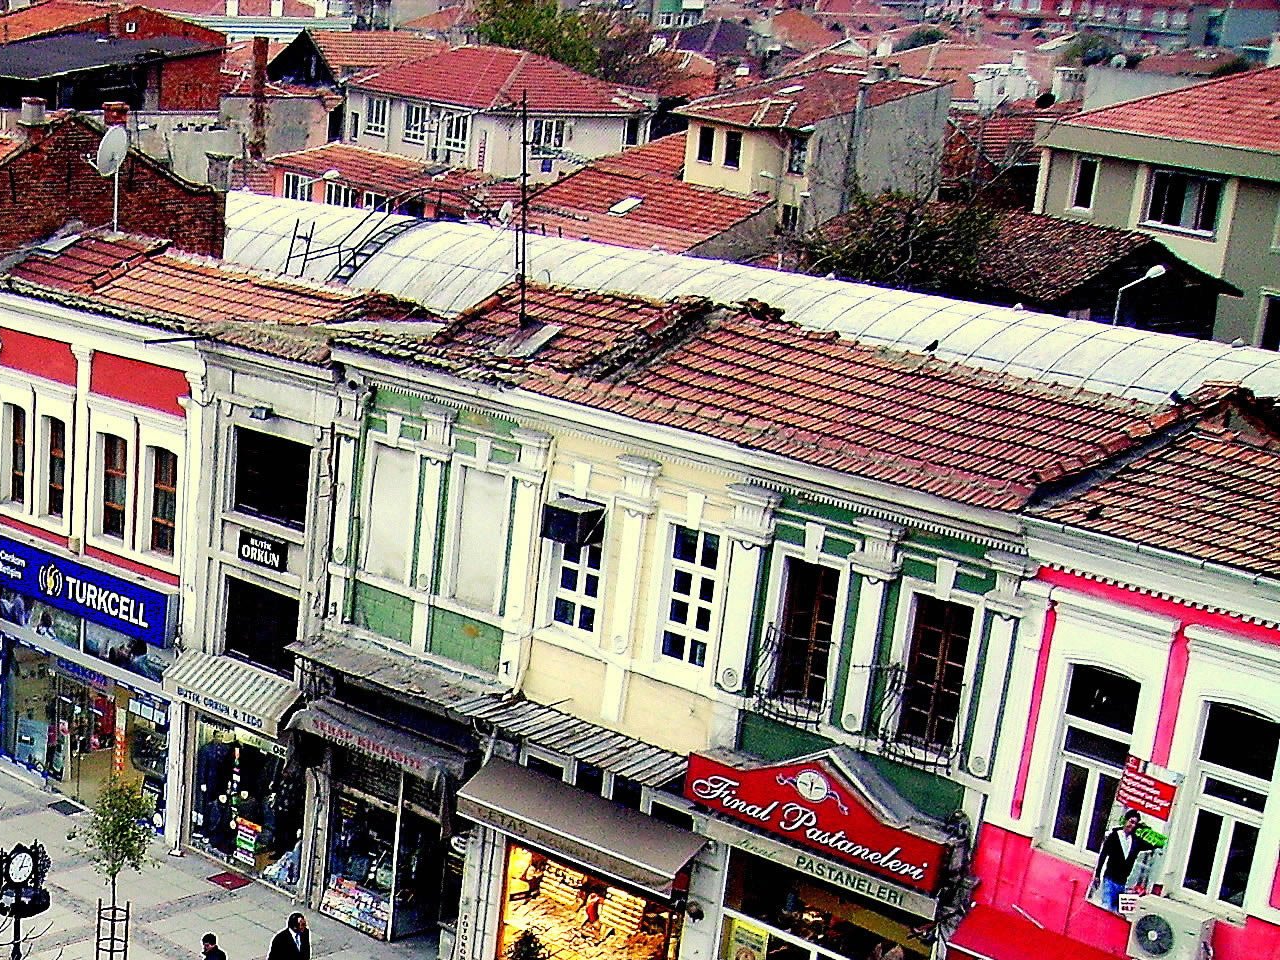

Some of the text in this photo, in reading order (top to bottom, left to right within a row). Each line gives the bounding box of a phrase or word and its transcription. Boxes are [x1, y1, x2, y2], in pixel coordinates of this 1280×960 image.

[241, 544, 280, 568] ORKUN
[65, 576, 149, 629] TURKCELL
[232, 709, 239, 720] &
[692, 775, 929, 881] Final Pastaneleri
